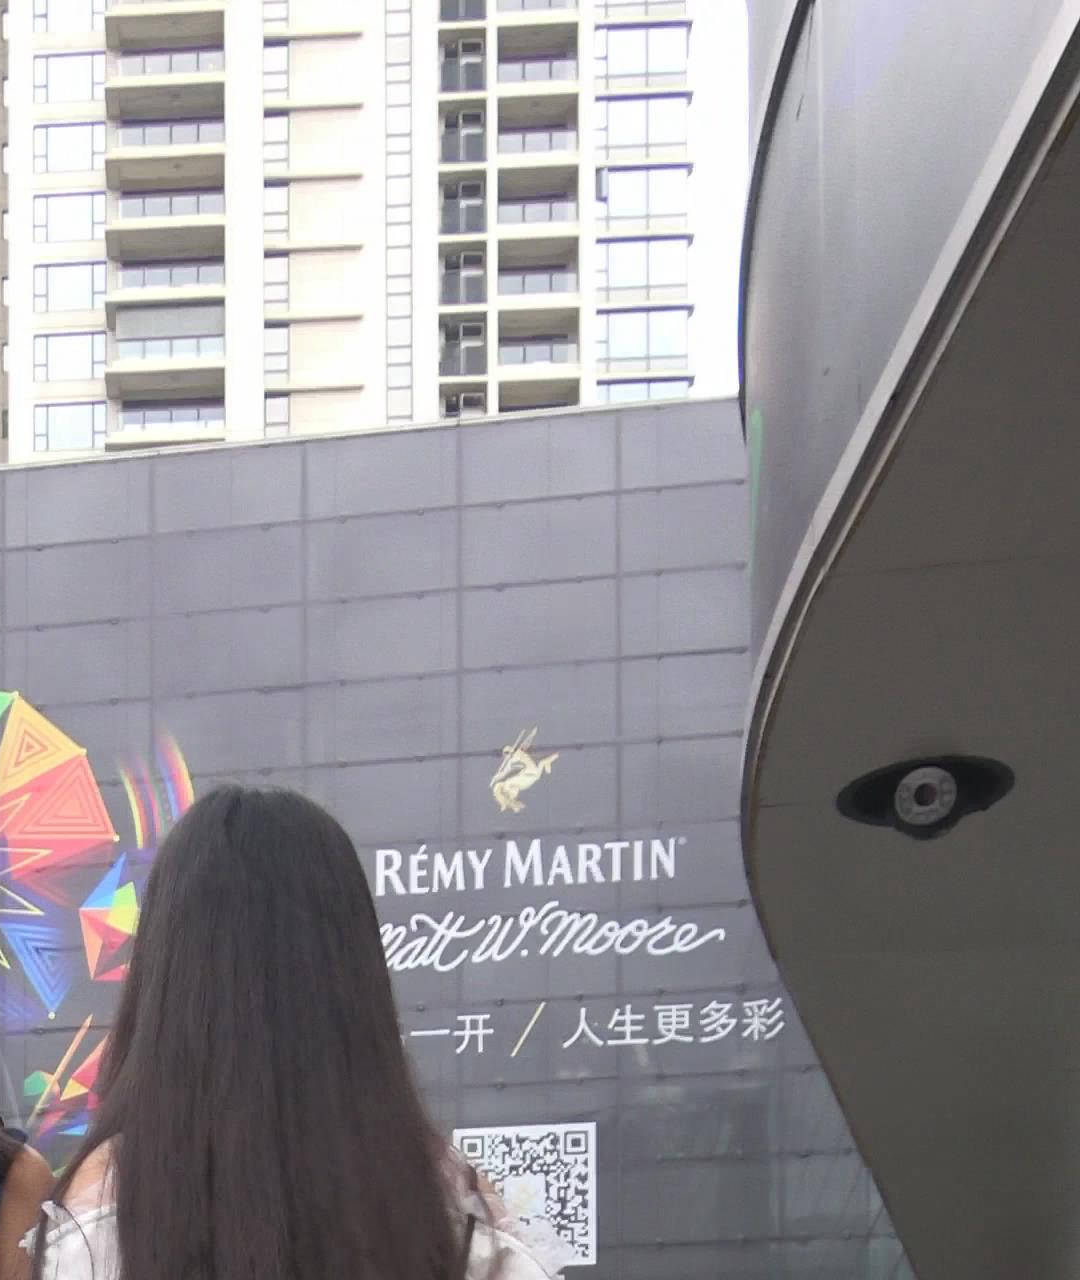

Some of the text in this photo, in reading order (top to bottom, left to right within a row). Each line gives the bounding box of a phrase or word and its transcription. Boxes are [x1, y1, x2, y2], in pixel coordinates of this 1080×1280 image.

[375, 845, 492, 897] RÉMY
[539, 910, 726, 958] Moore
[400, 1013, 495, 1055] 一开
[562, 997, 787, 1050] 人生更多彩
